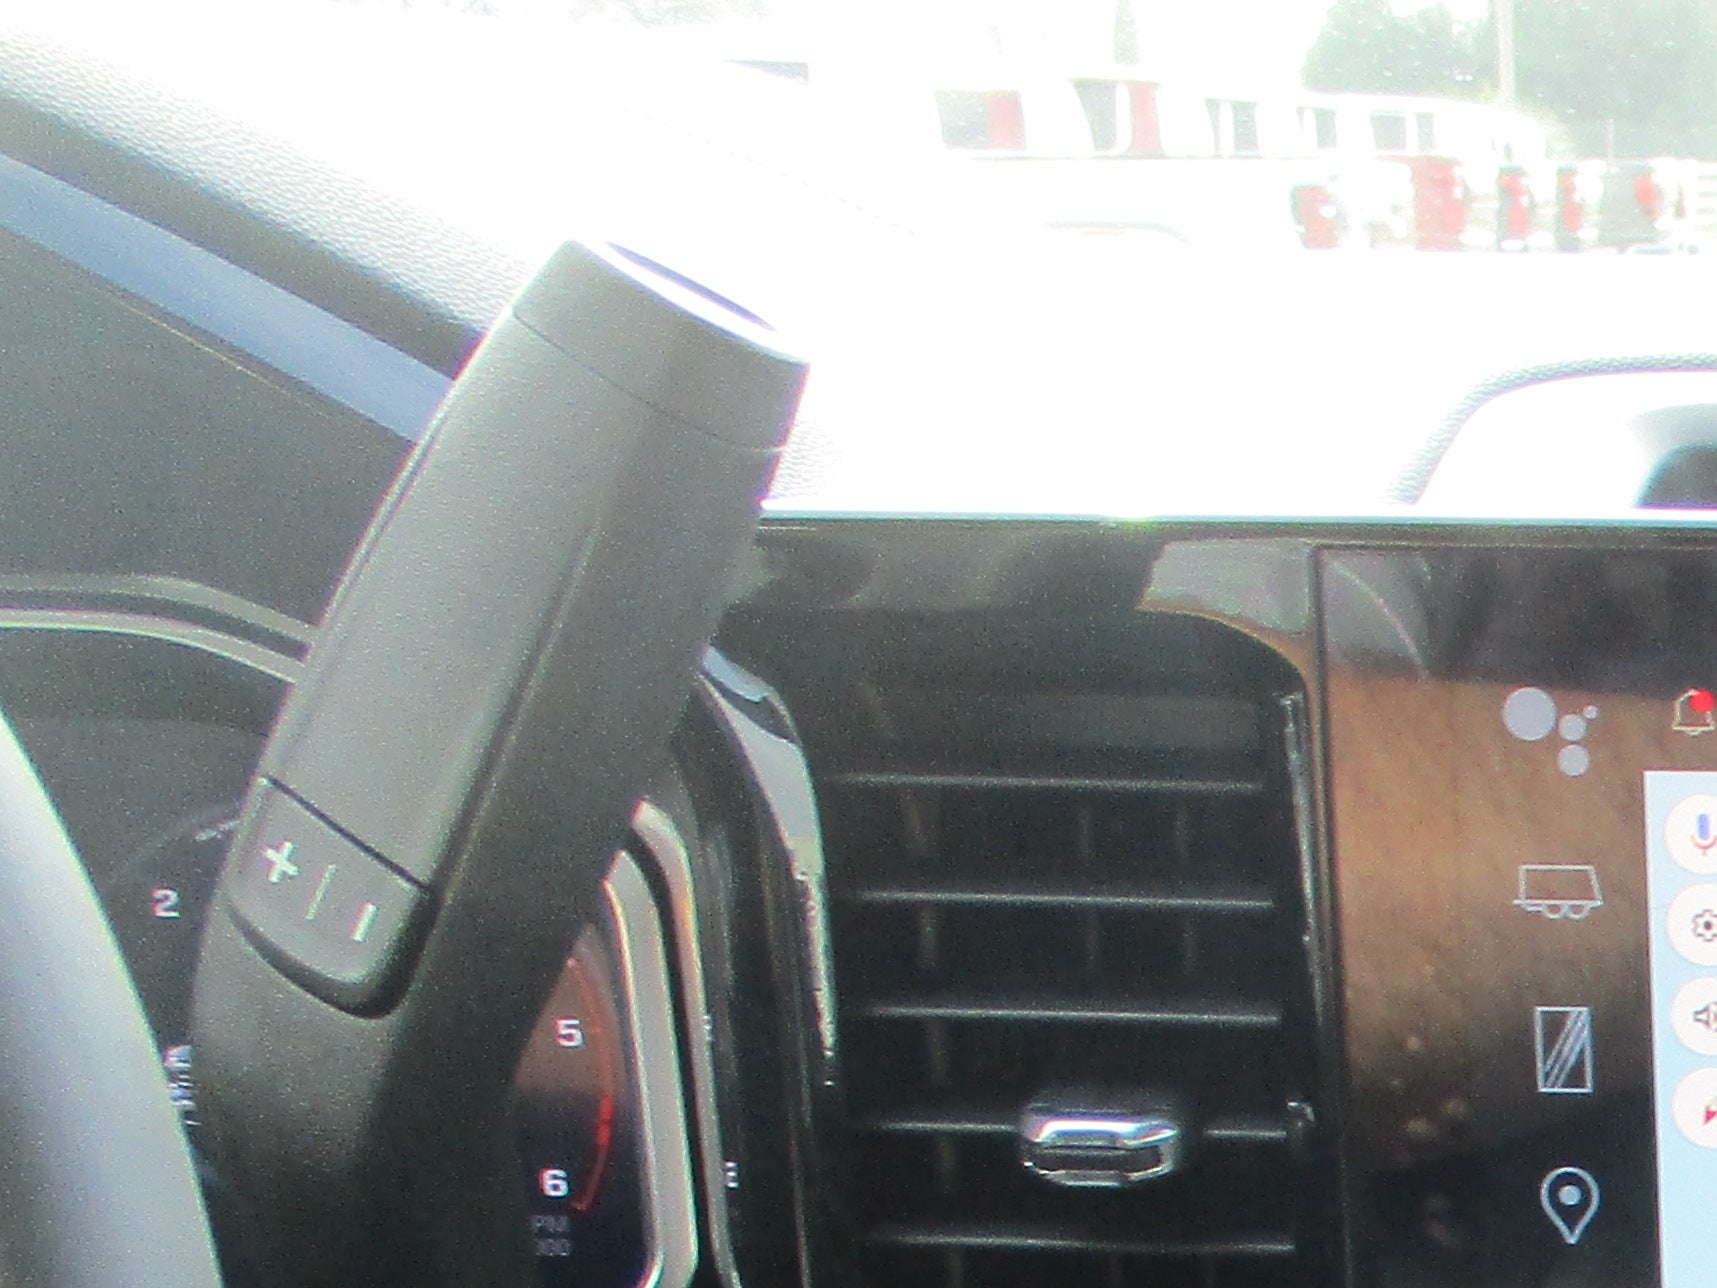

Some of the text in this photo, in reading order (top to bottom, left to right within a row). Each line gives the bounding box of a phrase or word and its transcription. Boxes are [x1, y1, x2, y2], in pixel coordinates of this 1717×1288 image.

[151, 888, 181, 919] 2
[555, 1017, 585, 1048] 5
[540, 1168, 570, 1198] 6
